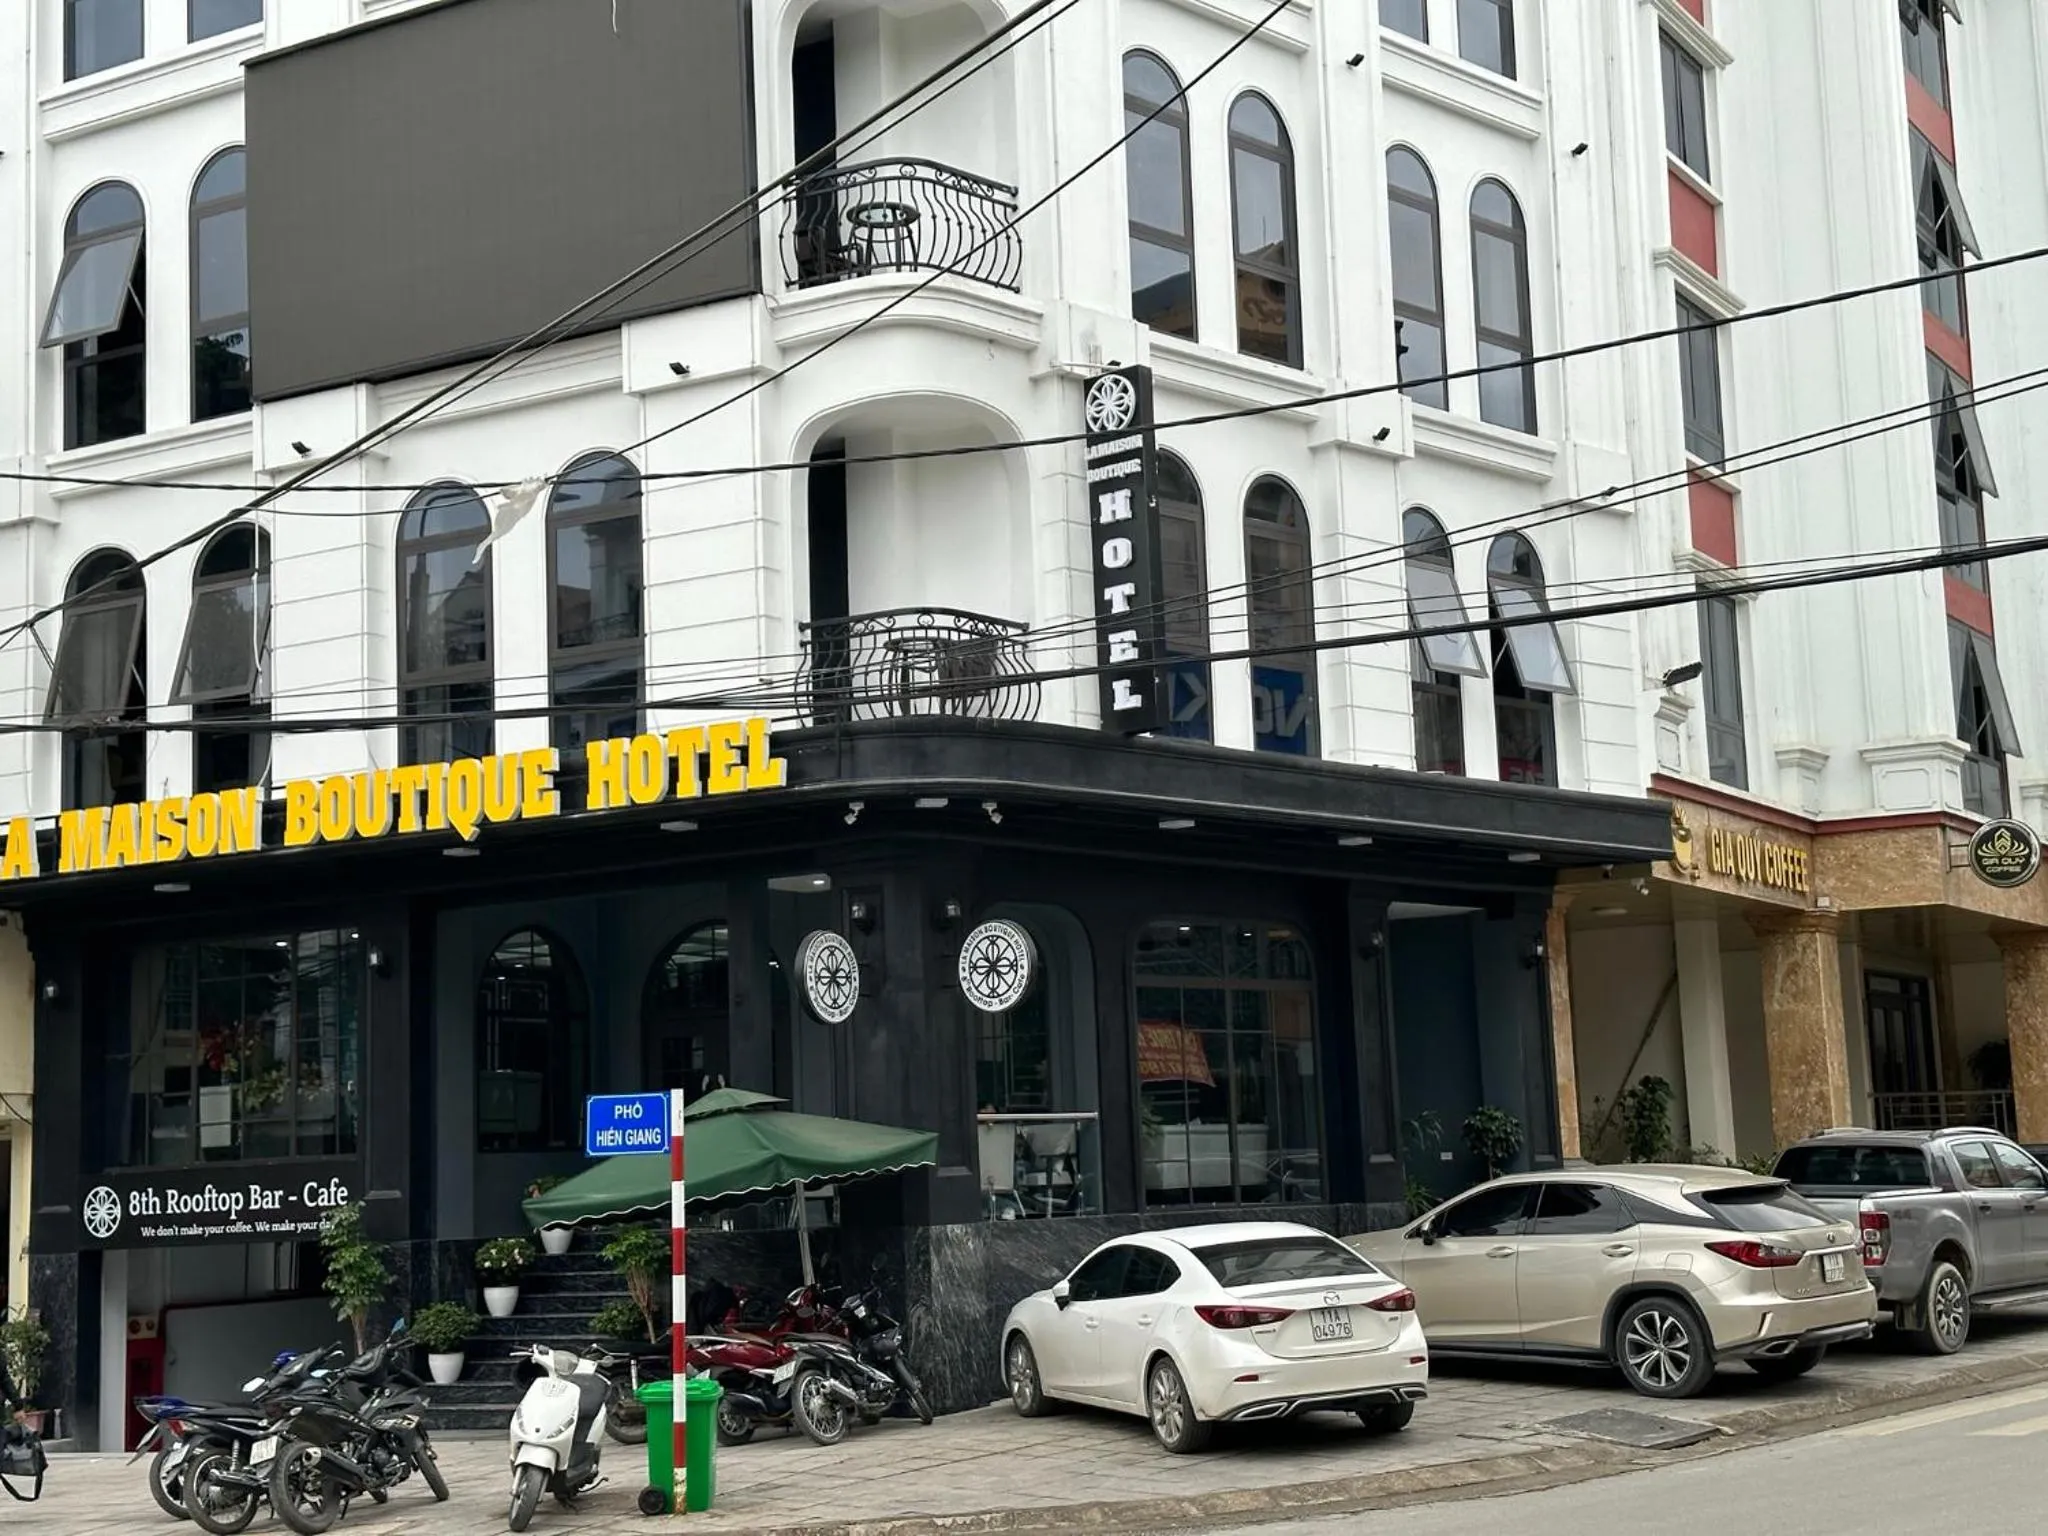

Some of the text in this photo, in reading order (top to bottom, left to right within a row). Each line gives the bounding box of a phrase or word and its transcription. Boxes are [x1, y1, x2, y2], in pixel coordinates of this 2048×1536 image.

[1086, 458, 1141, 483] BOUTIQUE
[1099, 488, 1142, 711] HOTEL
[0, 717, 787, 880] A MAISON BOUTIQUE HOTEL
[1710, 828, 1735, 875] GIA
[1764, 841, 1810, 893] COFFEE
[625, 1127, 661, 1145] GIANG
[129, 1188, 161, 1216] 8th
[166, 1184, 244, 1220] Rooftop
[249, 1184, 284, 1210] Bar
[303, 1177, 348, 1207] Cafe
[141, 1226, 156, 1237] We
[156, 1225, 179, 1236] don't
[180, 1223, 203, 1235] make
[204, 1225, 225, 1237] your
[226, 1221, 254, 1233] coffee.
[254, 1221, 270, 1232] We
[271, 1219, 295, 1231] make
[296, 1220, 319, 1234] your
[1321, 1309, 1340, 1324] 11A
[1314, 1323, 1351, 1338] 04976
